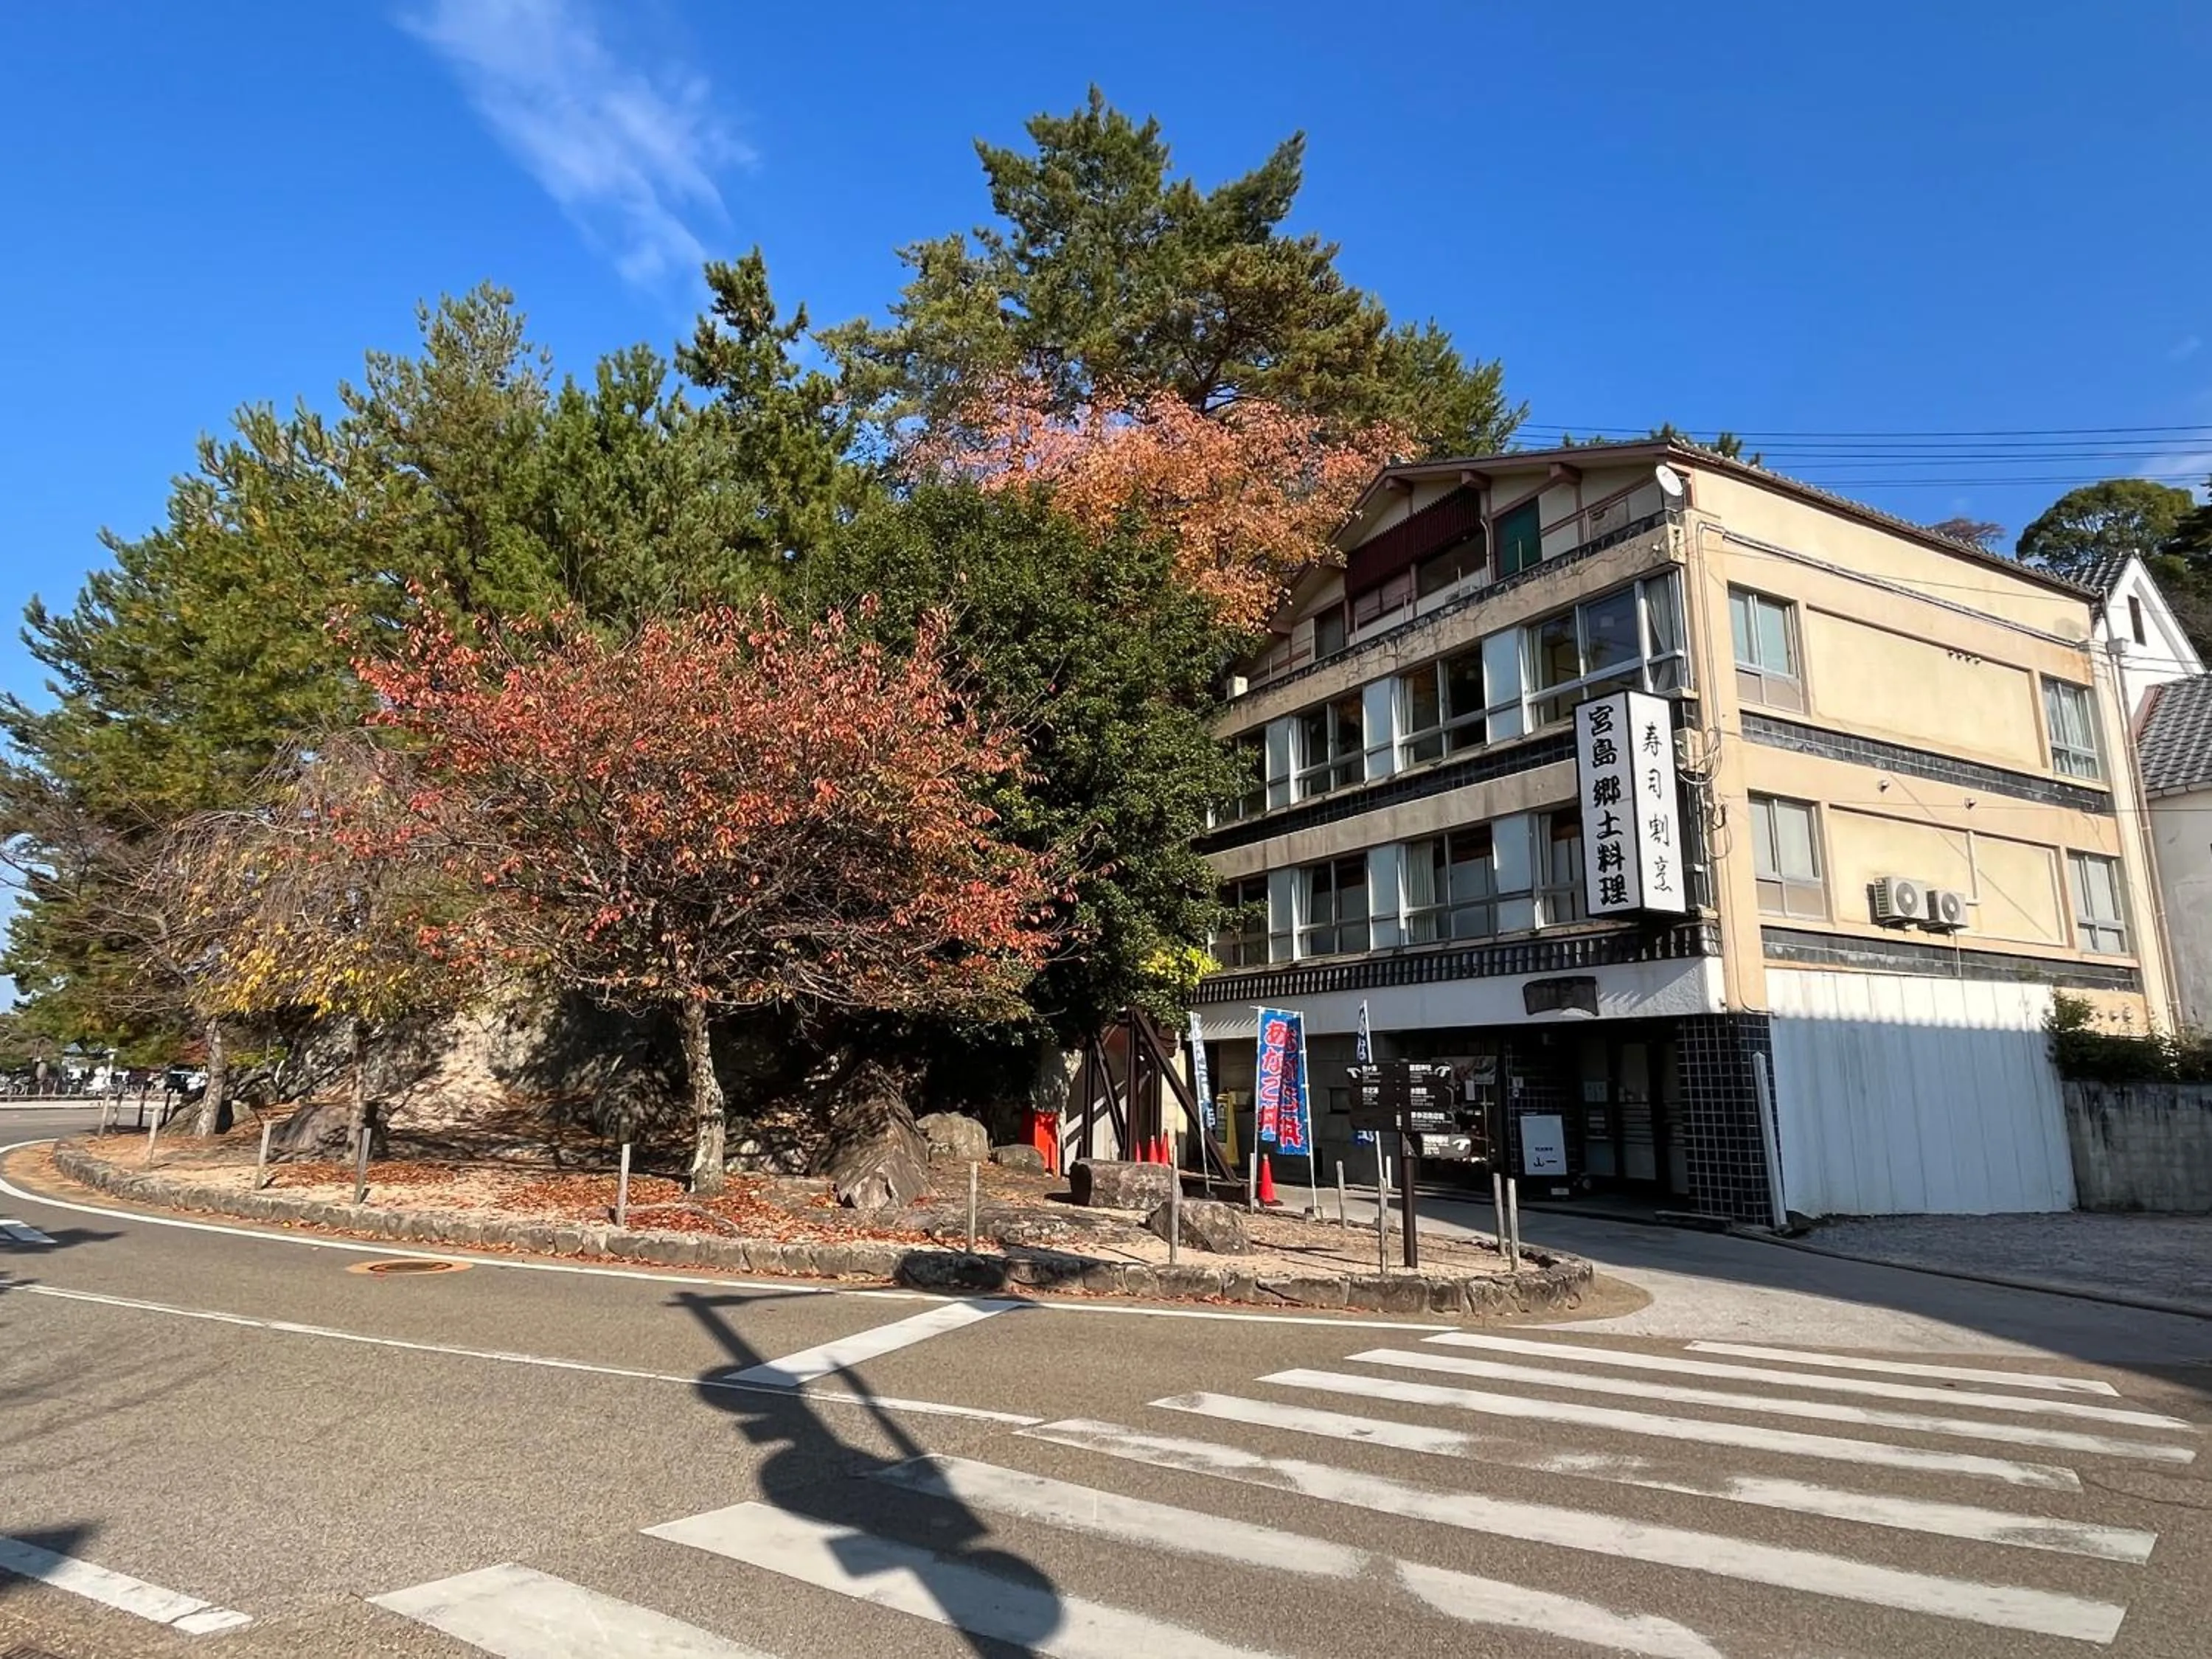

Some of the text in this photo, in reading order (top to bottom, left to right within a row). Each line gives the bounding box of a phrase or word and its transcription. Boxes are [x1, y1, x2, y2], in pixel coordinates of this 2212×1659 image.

[1588, 705, 1629, 906] 宮島郷土料理
[1643, 721, 1672, 893] 寿司割烹
